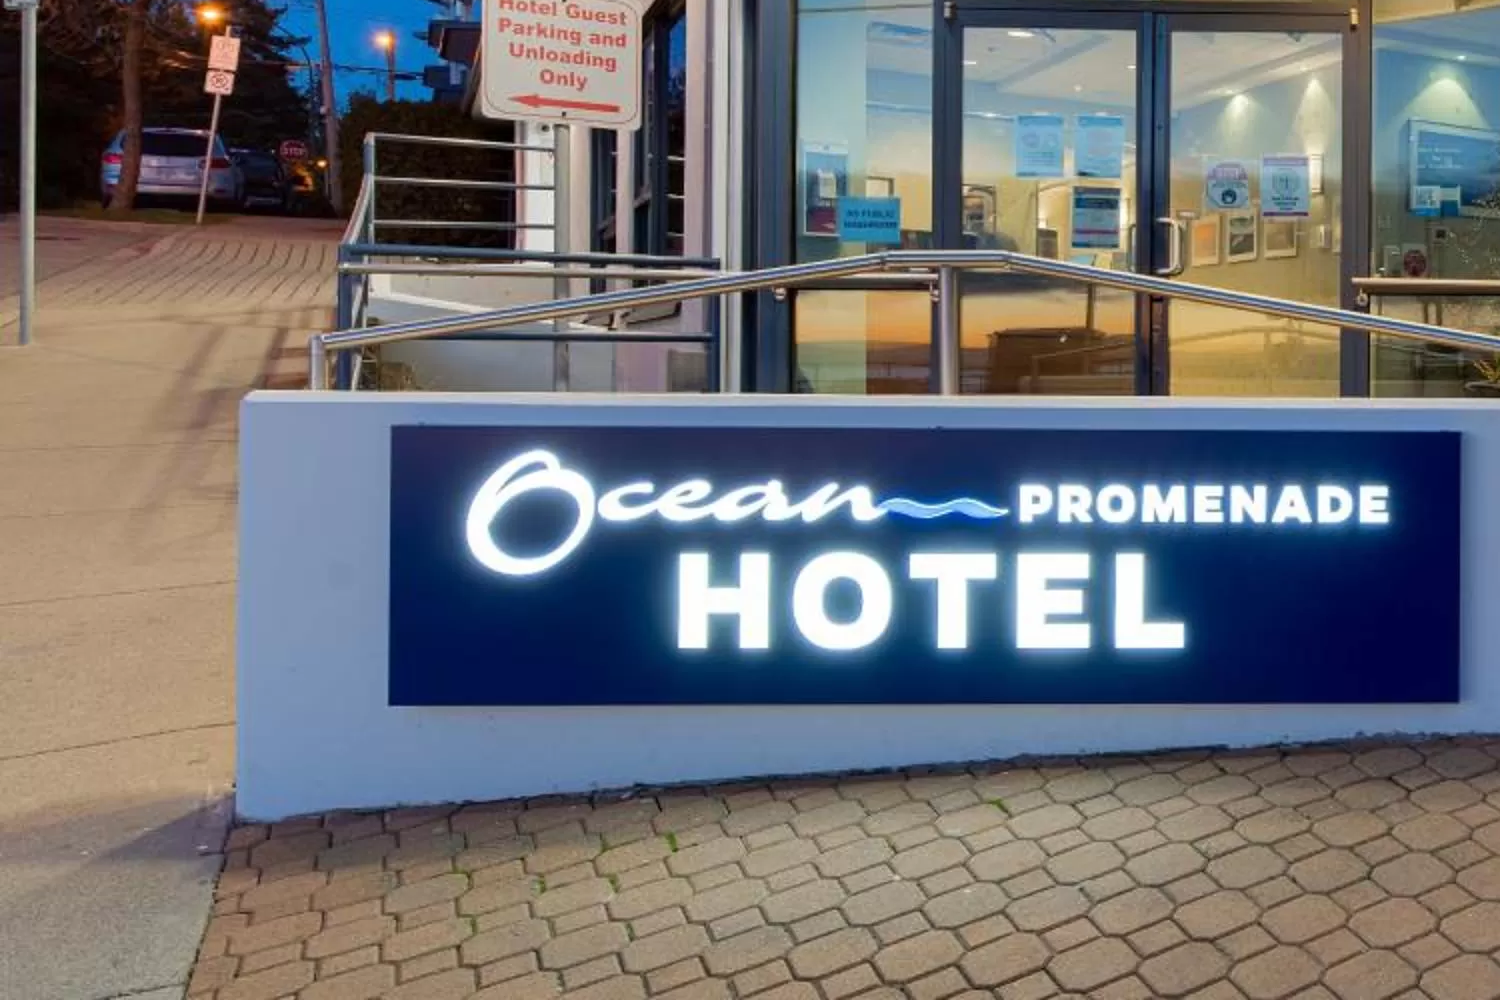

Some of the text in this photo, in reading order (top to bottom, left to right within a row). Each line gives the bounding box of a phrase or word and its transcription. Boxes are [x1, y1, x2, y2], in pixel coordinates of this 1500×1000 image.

[566, 3, 627, 25] Guest
[497, 17, 627, 48] Parking and
[509, 41, 617, 72] Unloading
[540, 68, 588, 91] Only
[465, 447, 1391, 577] Ocean PROMENADE
[675, 548, 1187, 652] HOTEL
